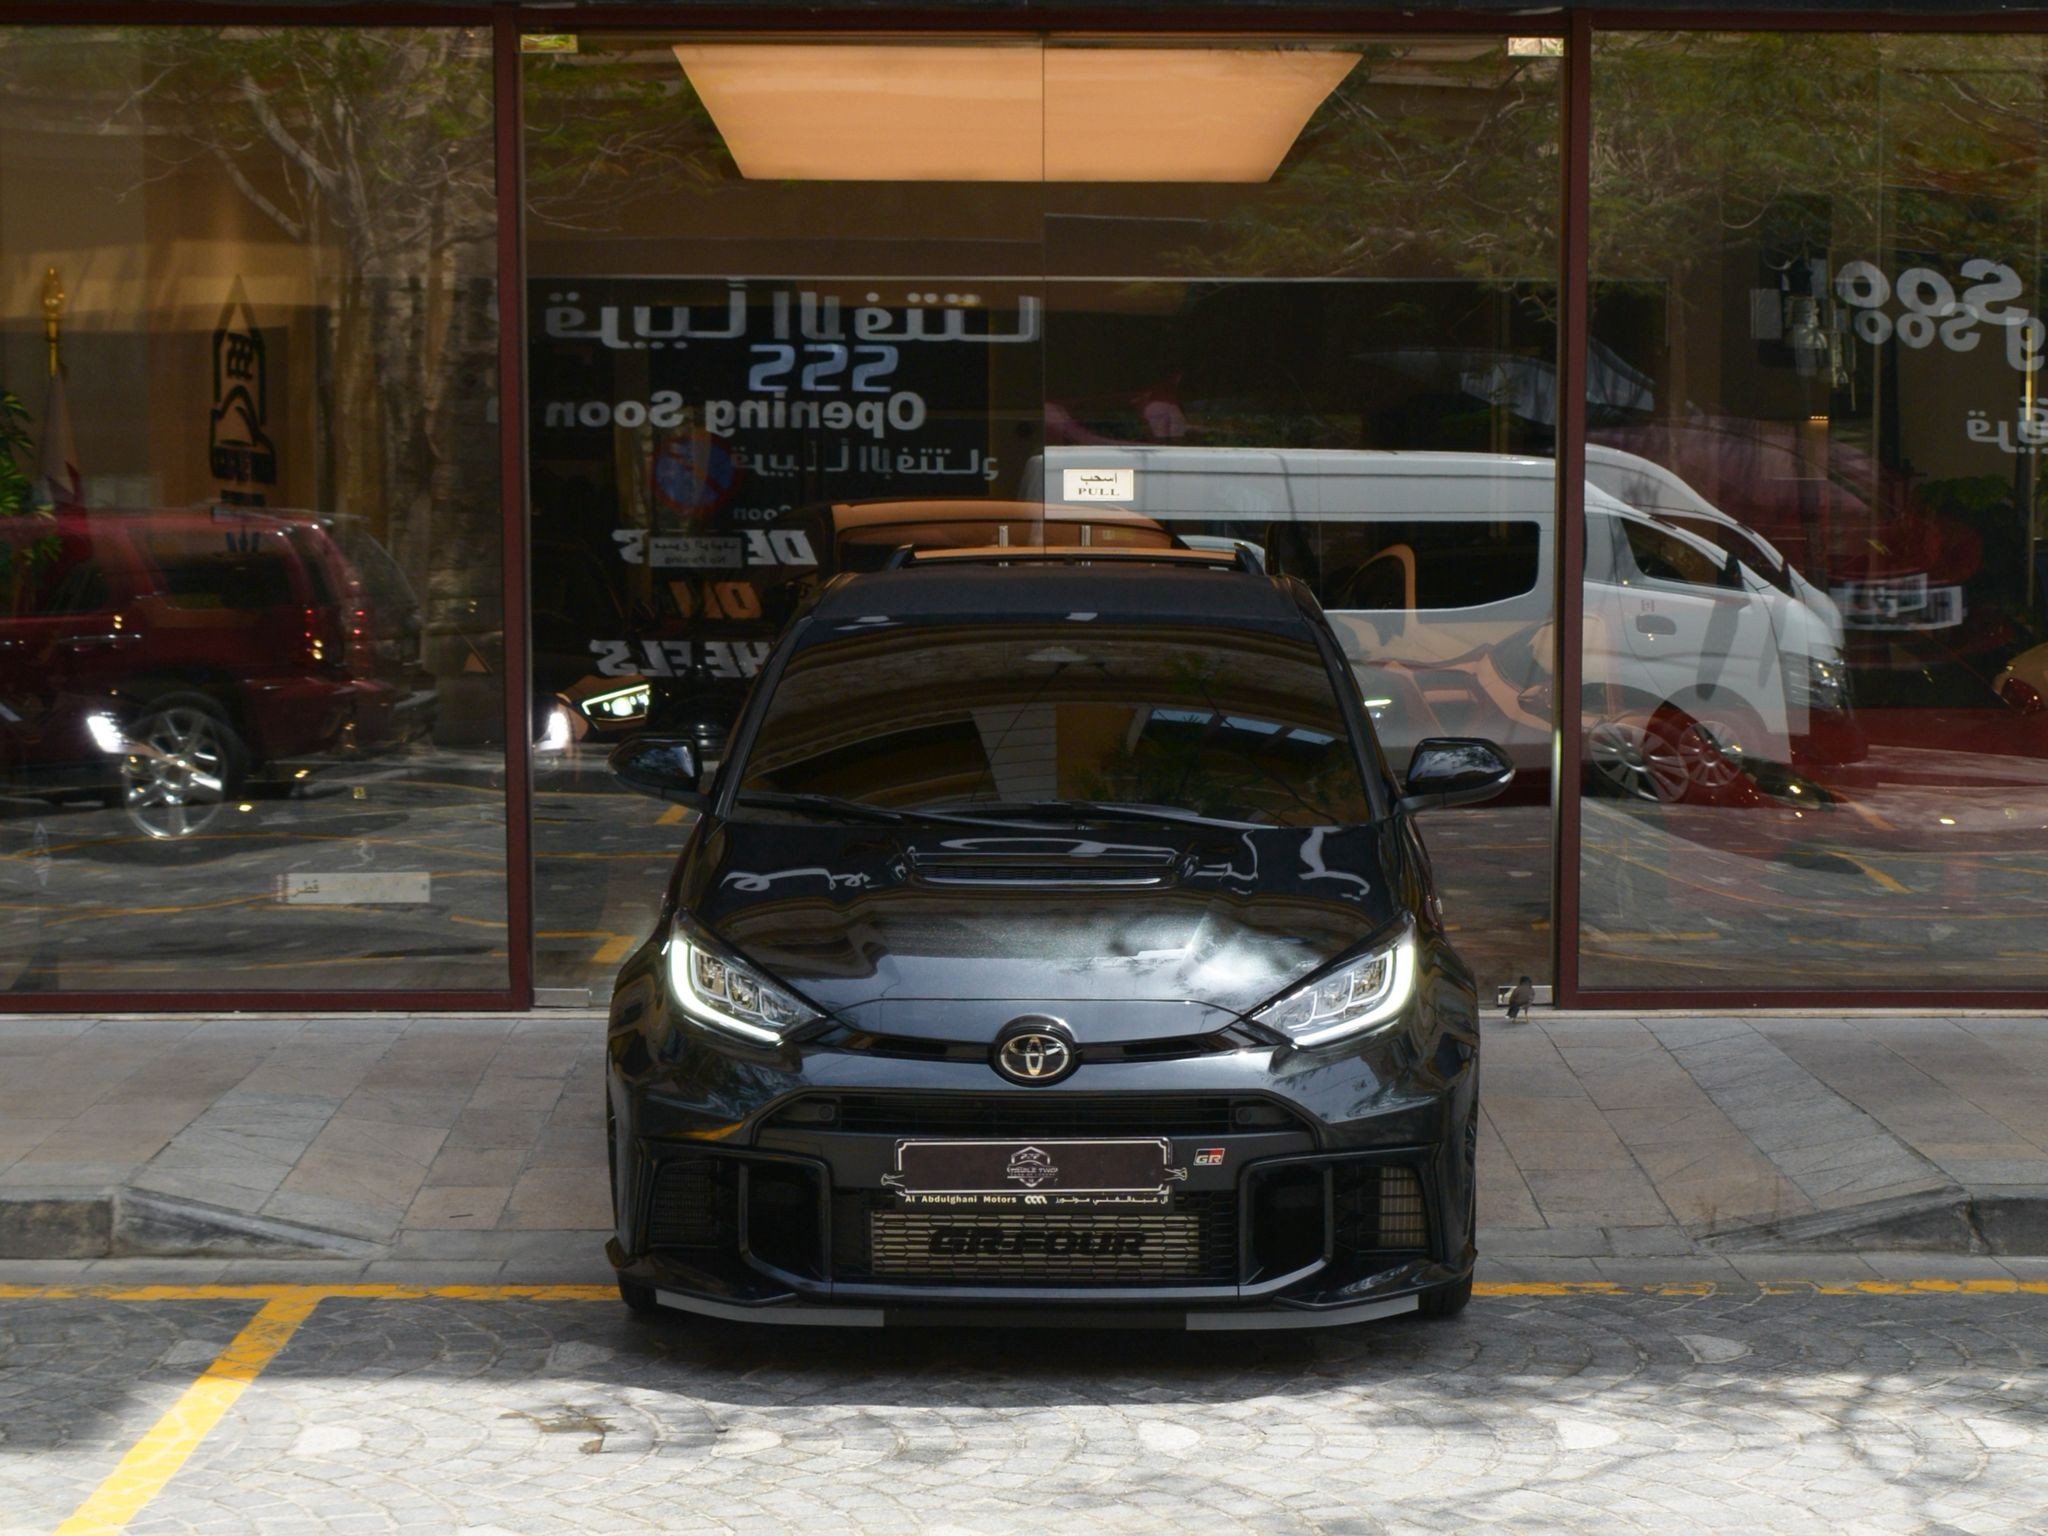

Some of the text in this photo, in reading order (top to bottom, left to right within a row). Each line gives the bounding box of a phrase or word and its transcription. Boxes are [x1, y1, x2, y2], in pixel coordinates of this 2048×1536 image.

[1078, 487, 1120, 496] PULL
[1196, 1154, 1222, 1163] GR
[921, 1194, 977, 1205] Abdulghani
[983, 1195, 1017, 1204] Motors
